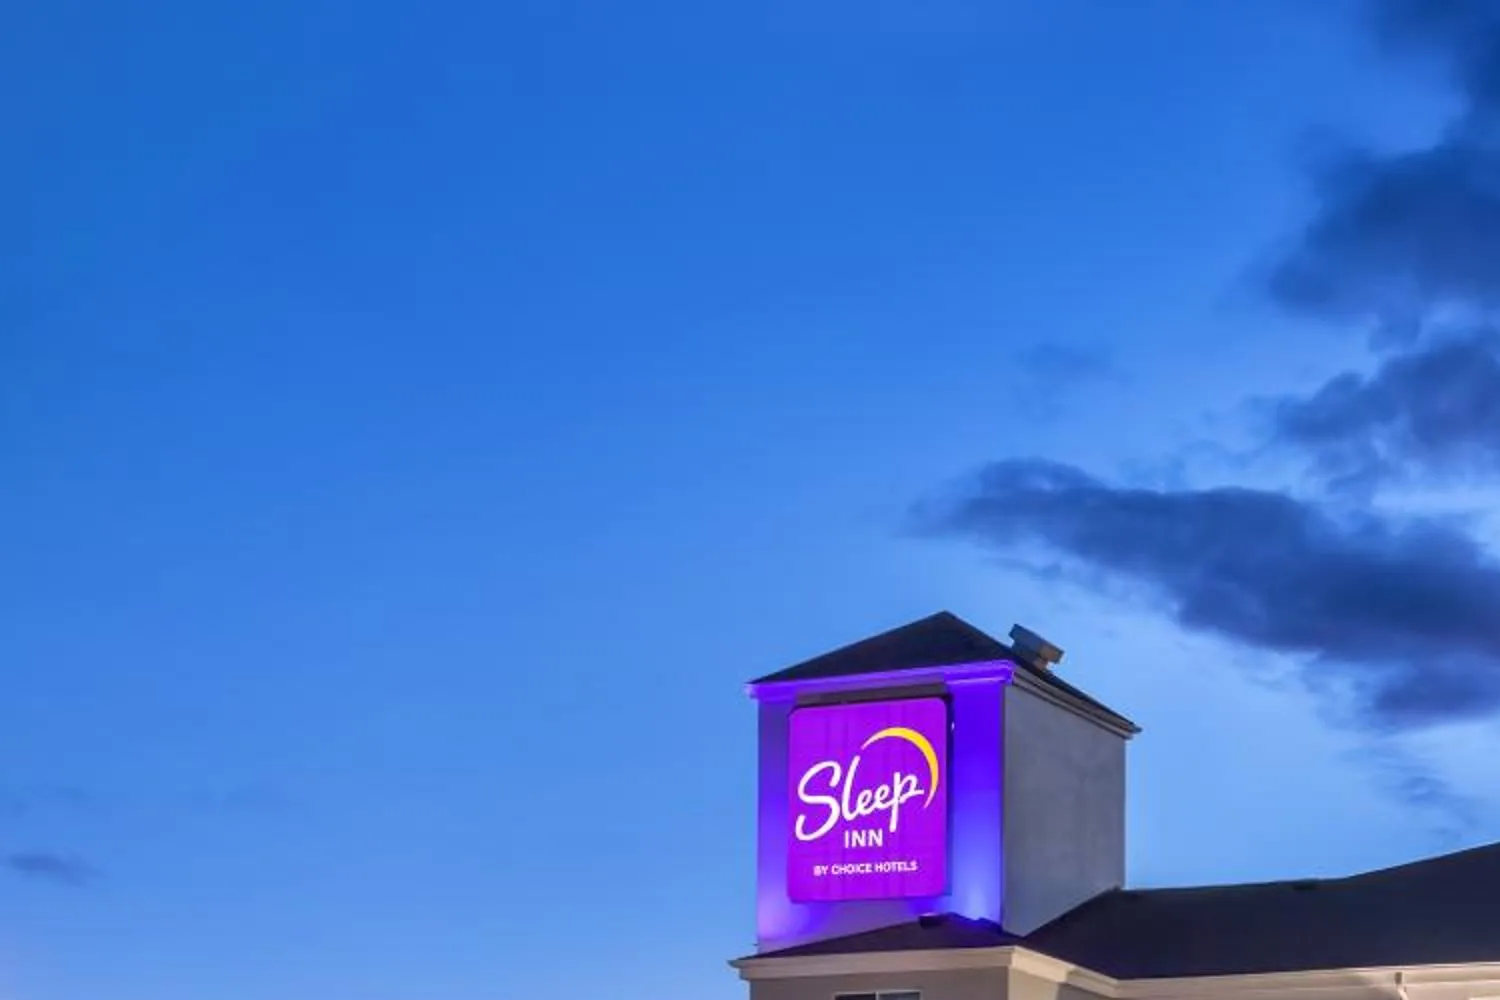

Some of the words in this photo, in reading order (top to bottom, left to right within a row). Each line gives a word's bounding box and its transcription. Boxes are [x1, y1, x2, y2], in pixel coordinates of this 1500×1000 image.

[795, 755, 925, 841] Sleep
[844, 828, 884, 849] INN
[813, 865, 829, 877] BY
[831, 863, 873, 876] CHOICE
[875, 860, 918, 873] HOTELS
